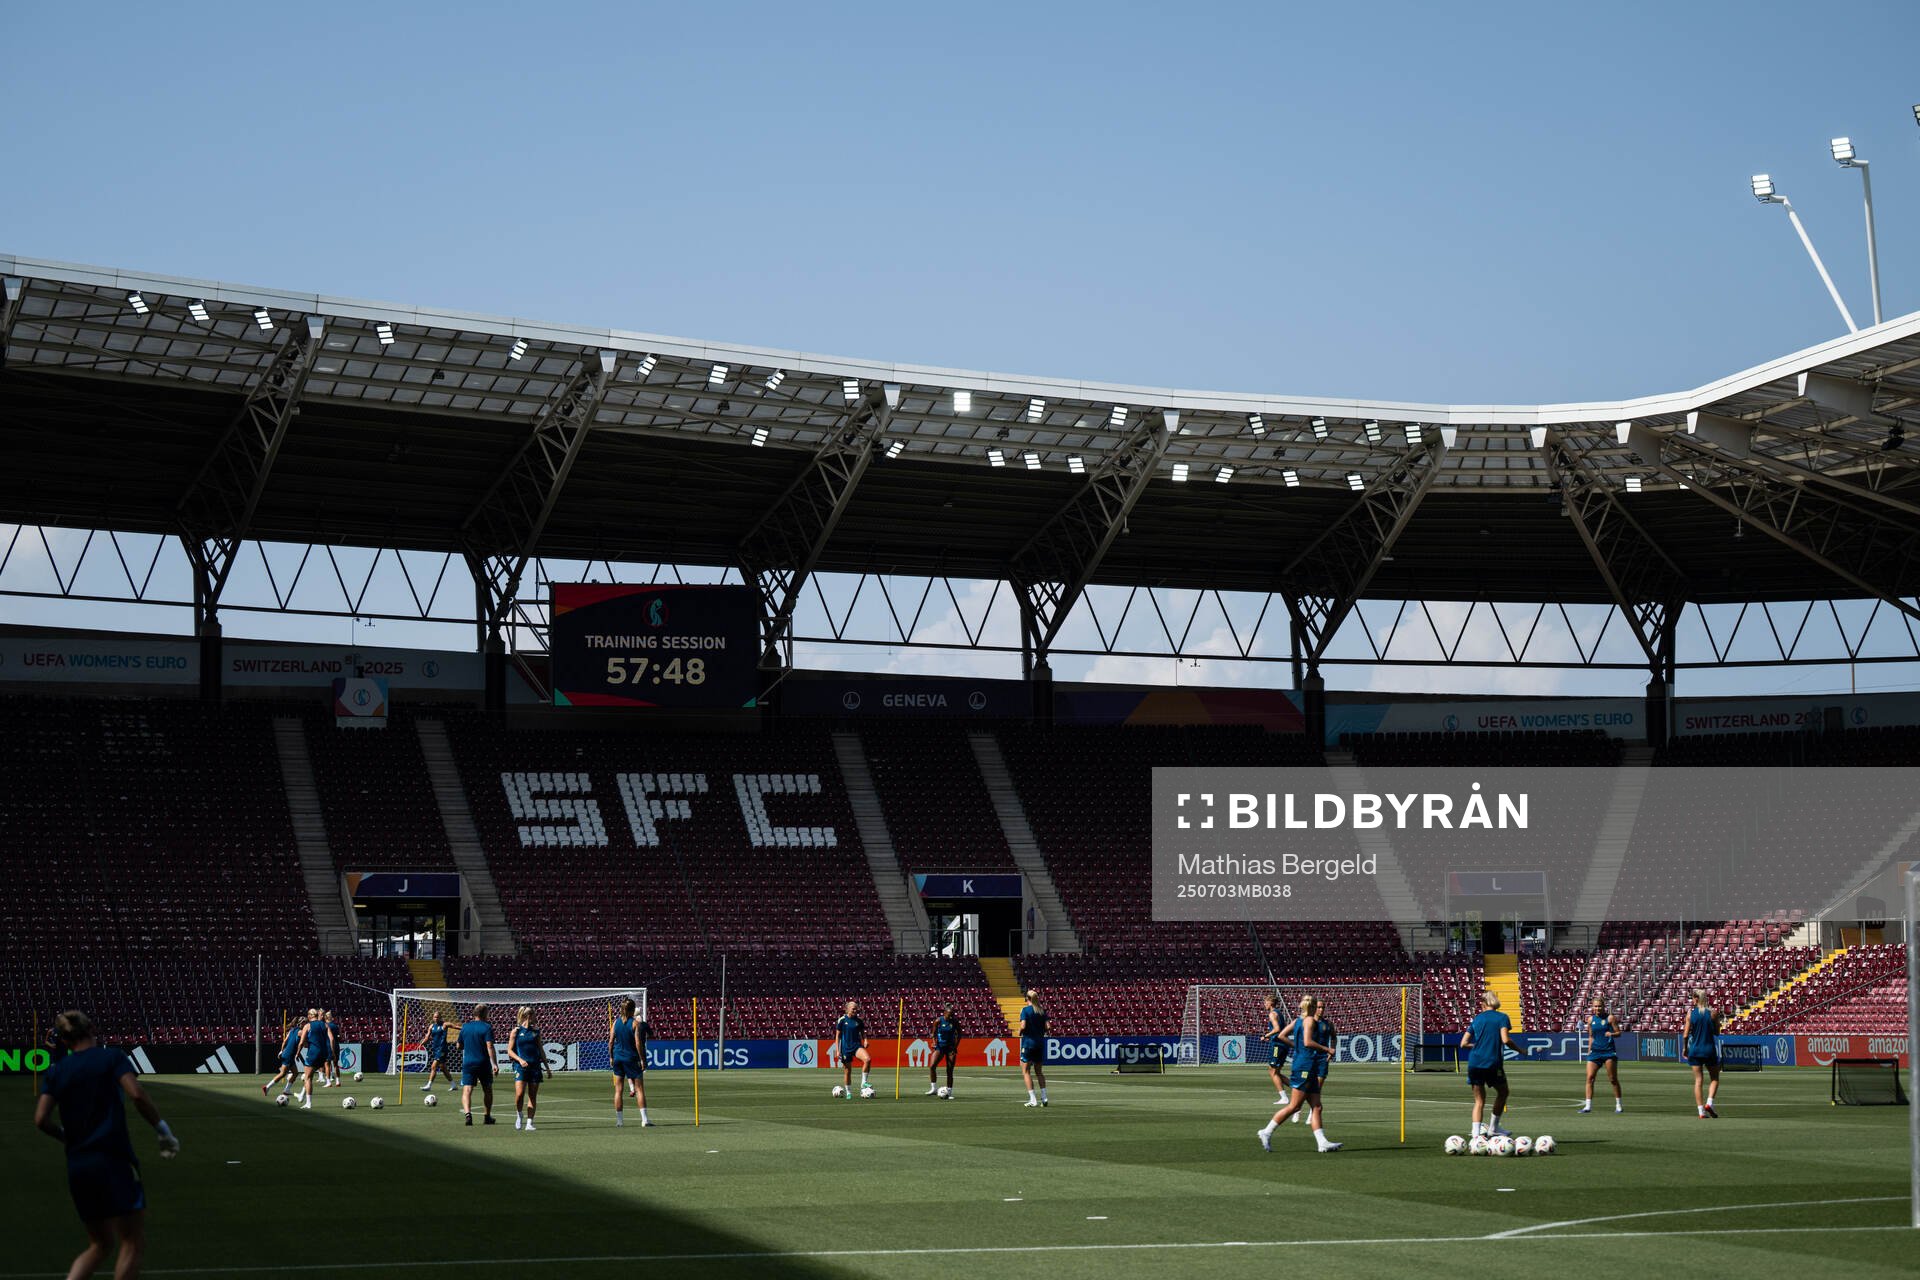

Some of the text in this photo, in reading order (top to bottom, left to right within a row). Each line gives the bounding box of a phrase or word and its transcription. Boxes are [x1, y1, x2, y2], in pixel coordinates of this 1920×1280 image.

[585, 635, 726, 649] TRAINING SESSION
[23, 653, 187, 669] UEFA WOMEN'S EURO
[233, 660, 403, 674] SWITZERLAND 2025
[606, 657, 706, 685] 57:48
[882, 694, 948, 707] GENEVA
[1478, 712, 1633, 729] UEFA WOMEN'S EURO
[1685, 713, 1790, 730] SWITZERLAND
[501, 772, 837, 848] SFC
[398, 879, 408, 893] J
[963, 879, 975, 893] K
[1492, 878, 1502, 891] L
[1046, 1037, 1194, 1064] Booking.com
[1641, 1037, 1677, 1058] #FOOTBALL
[1807, 1037, 1850, 1053] amazon
[396, 1053, 427, 1062] PEPSI
